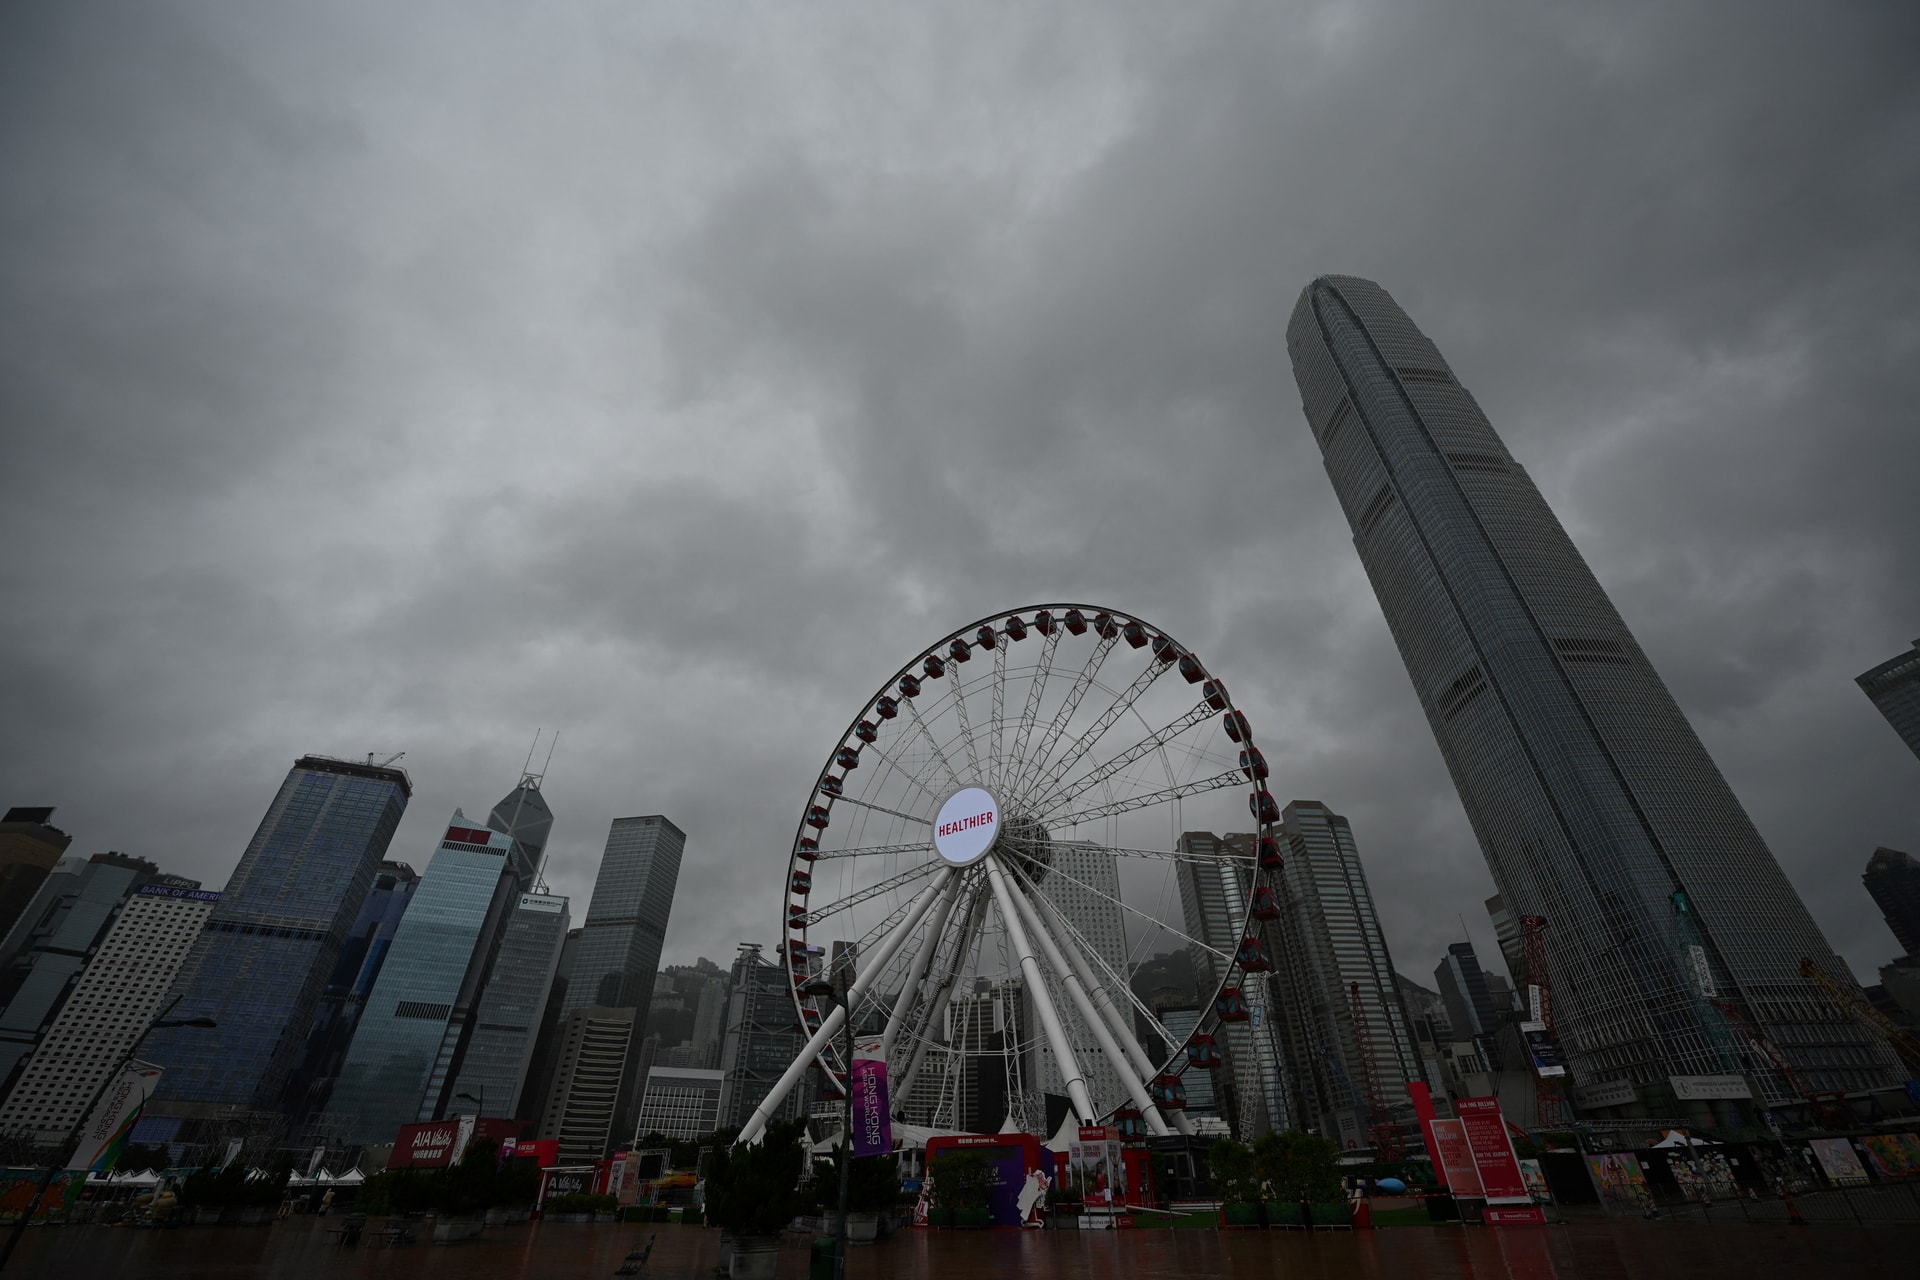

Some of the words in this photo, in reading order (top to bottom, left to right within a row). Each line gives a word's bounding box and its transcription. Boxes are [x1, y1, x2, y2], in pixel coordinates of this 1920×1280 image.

[939, 811, 993, 837] HEALTHIER
[141, 885, 169, 897] BANK
[171, 889, 187, 898] OF
[187, 891, 222, 901] AMERI
[163, 877, 195, 889] LIPPO
[113, 1081, 135, 1111] HONG
[867, 1067, 878, 1104] HONG
[97, 1111, 120, 1140] KONG
[865, 1126, 873, 1145] CITY
[870, 1106, 881, 1145] KONG
[411, 1130, 432, 1148] AIA
[431, 1127, 452, 1152] Vitality
